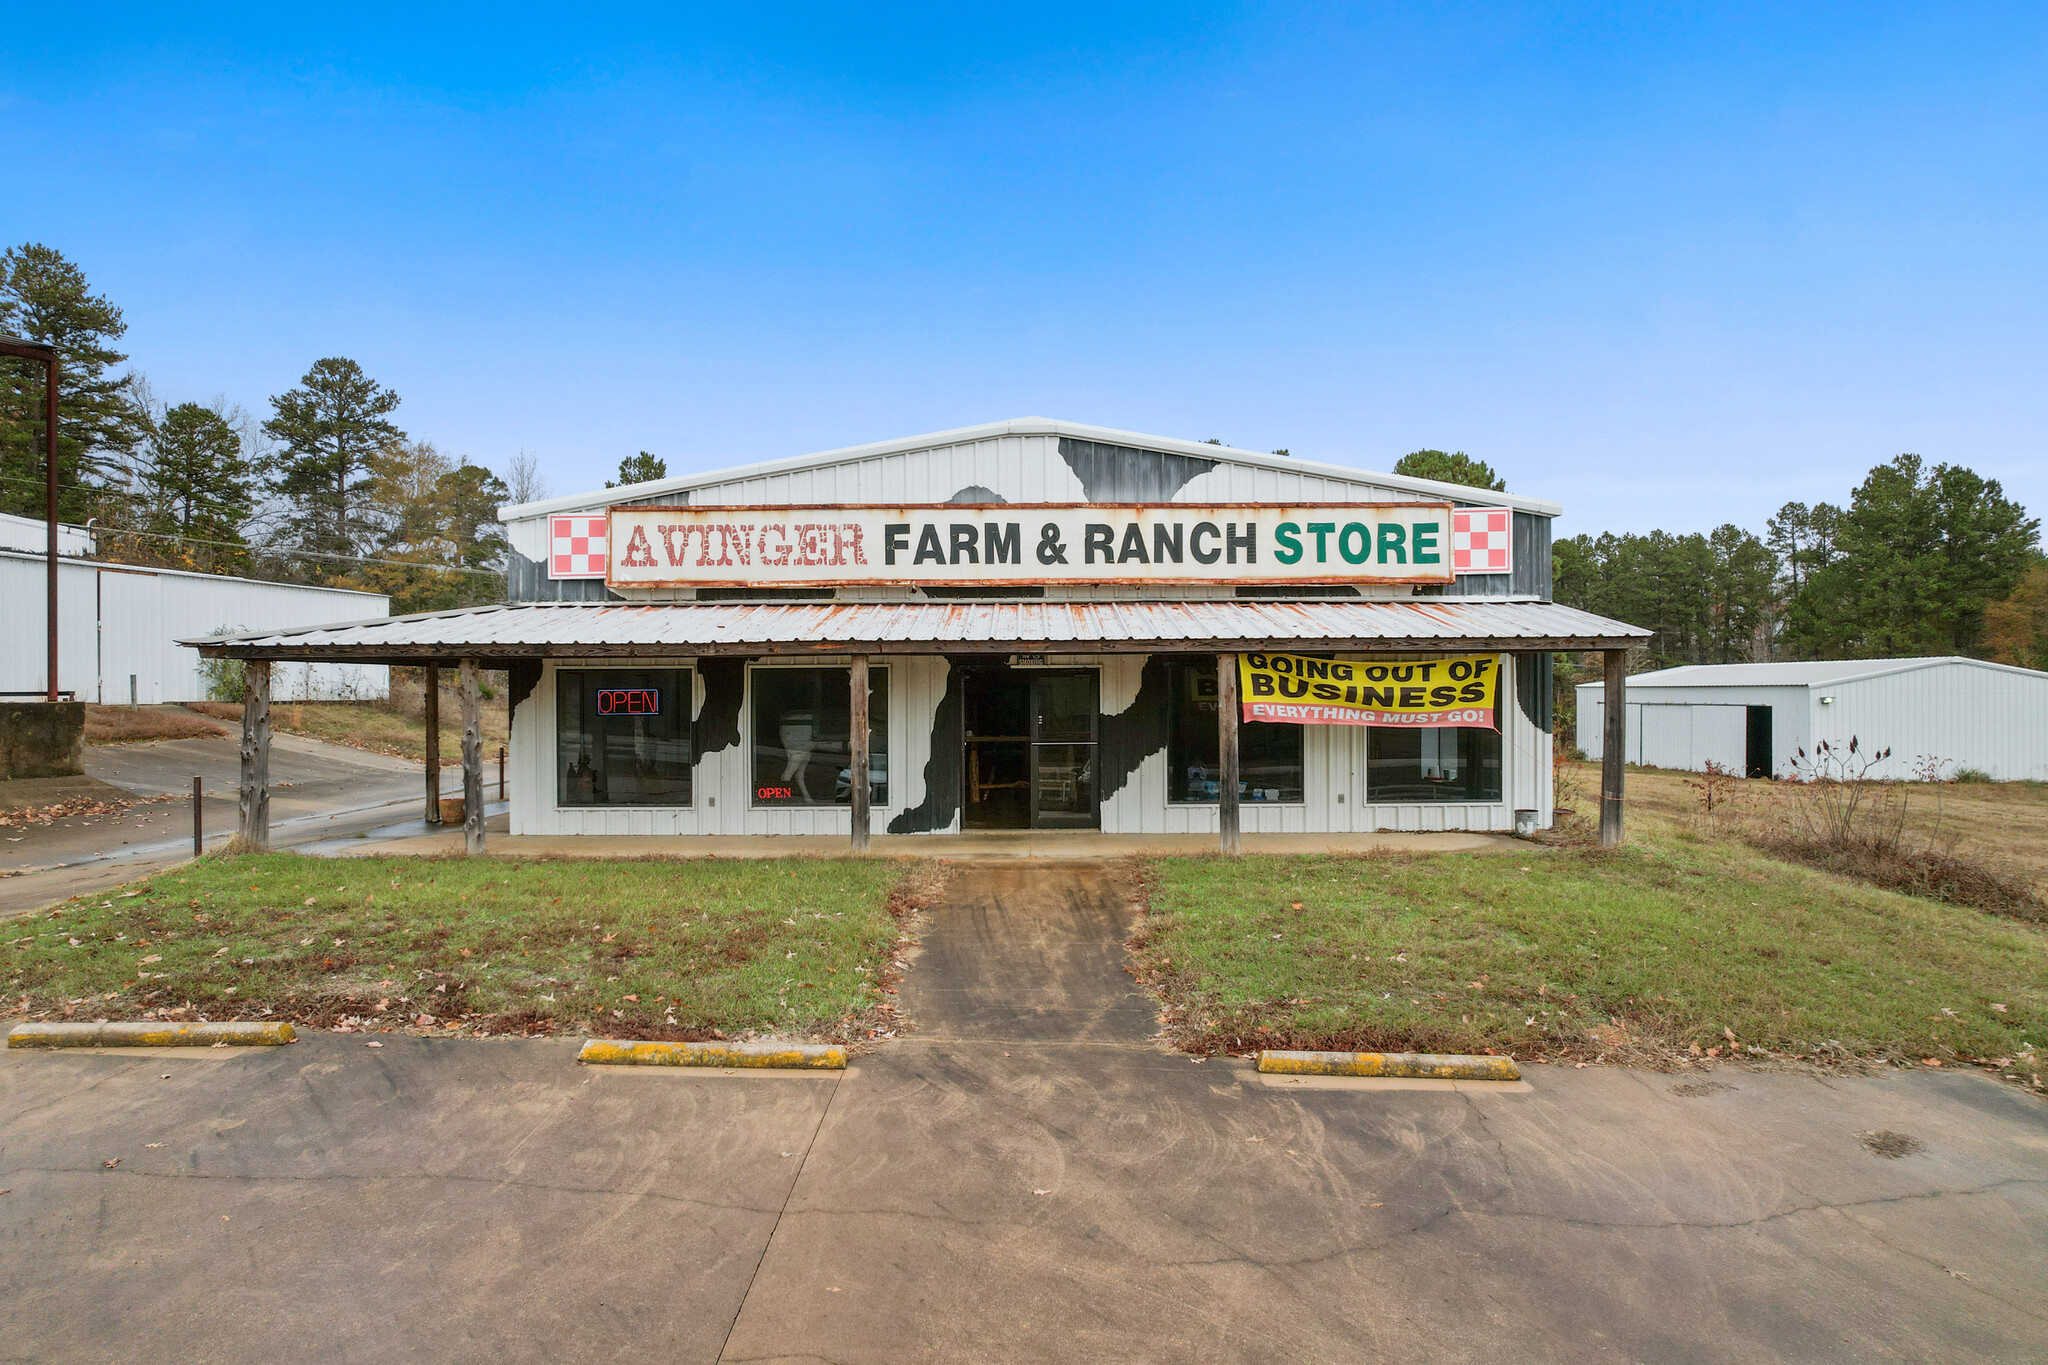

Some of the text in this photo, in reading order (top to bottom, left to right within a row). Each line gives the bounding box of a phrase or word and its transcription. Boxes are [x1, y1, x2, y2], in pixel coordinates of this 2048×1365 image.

[621, 522, 1440, 567] AVINGER FARM & RANCH STORE
[1247, 653, 1492, 682] GOING OUT OF
[599, 691, 656, 713] OPEN
[1251, 673, 1485, 708] BUSINESS
[1252, 704, 1484, 723] EVERYTHING MUST GO!
[758, 787, 792, 799] OPEN
